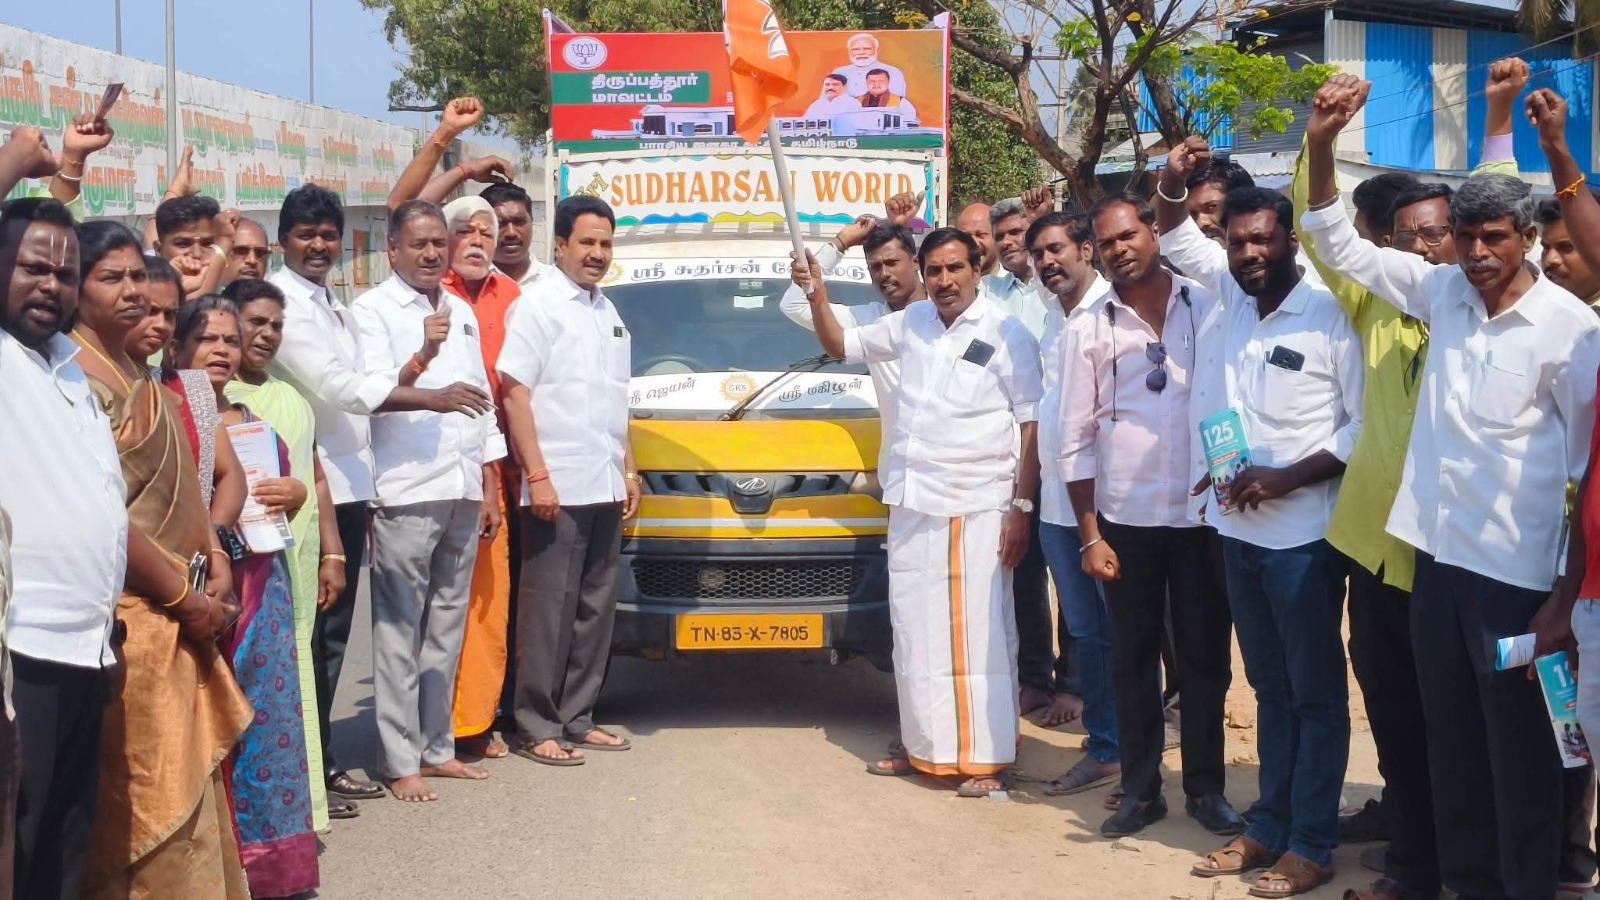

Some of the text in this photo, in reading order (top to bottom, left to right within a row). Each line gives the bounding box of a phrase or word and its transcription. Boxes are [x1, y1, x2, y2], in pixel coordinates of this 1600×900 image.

[592, 73, 698, 91] திருப்பத்தூர்
[592, 91, 673, 103] மாவட்டம்
[791, 138, 858, 149] தமிழ்நாடு
[811, 170, 913, 204] WORLD
[675, 259, 761, 277] சுதர்சன்
[728, 384, 747, 392] GKS
[807, 378, 863, 395] மகிழன்
[1203, 420, 1234, 448] 125
